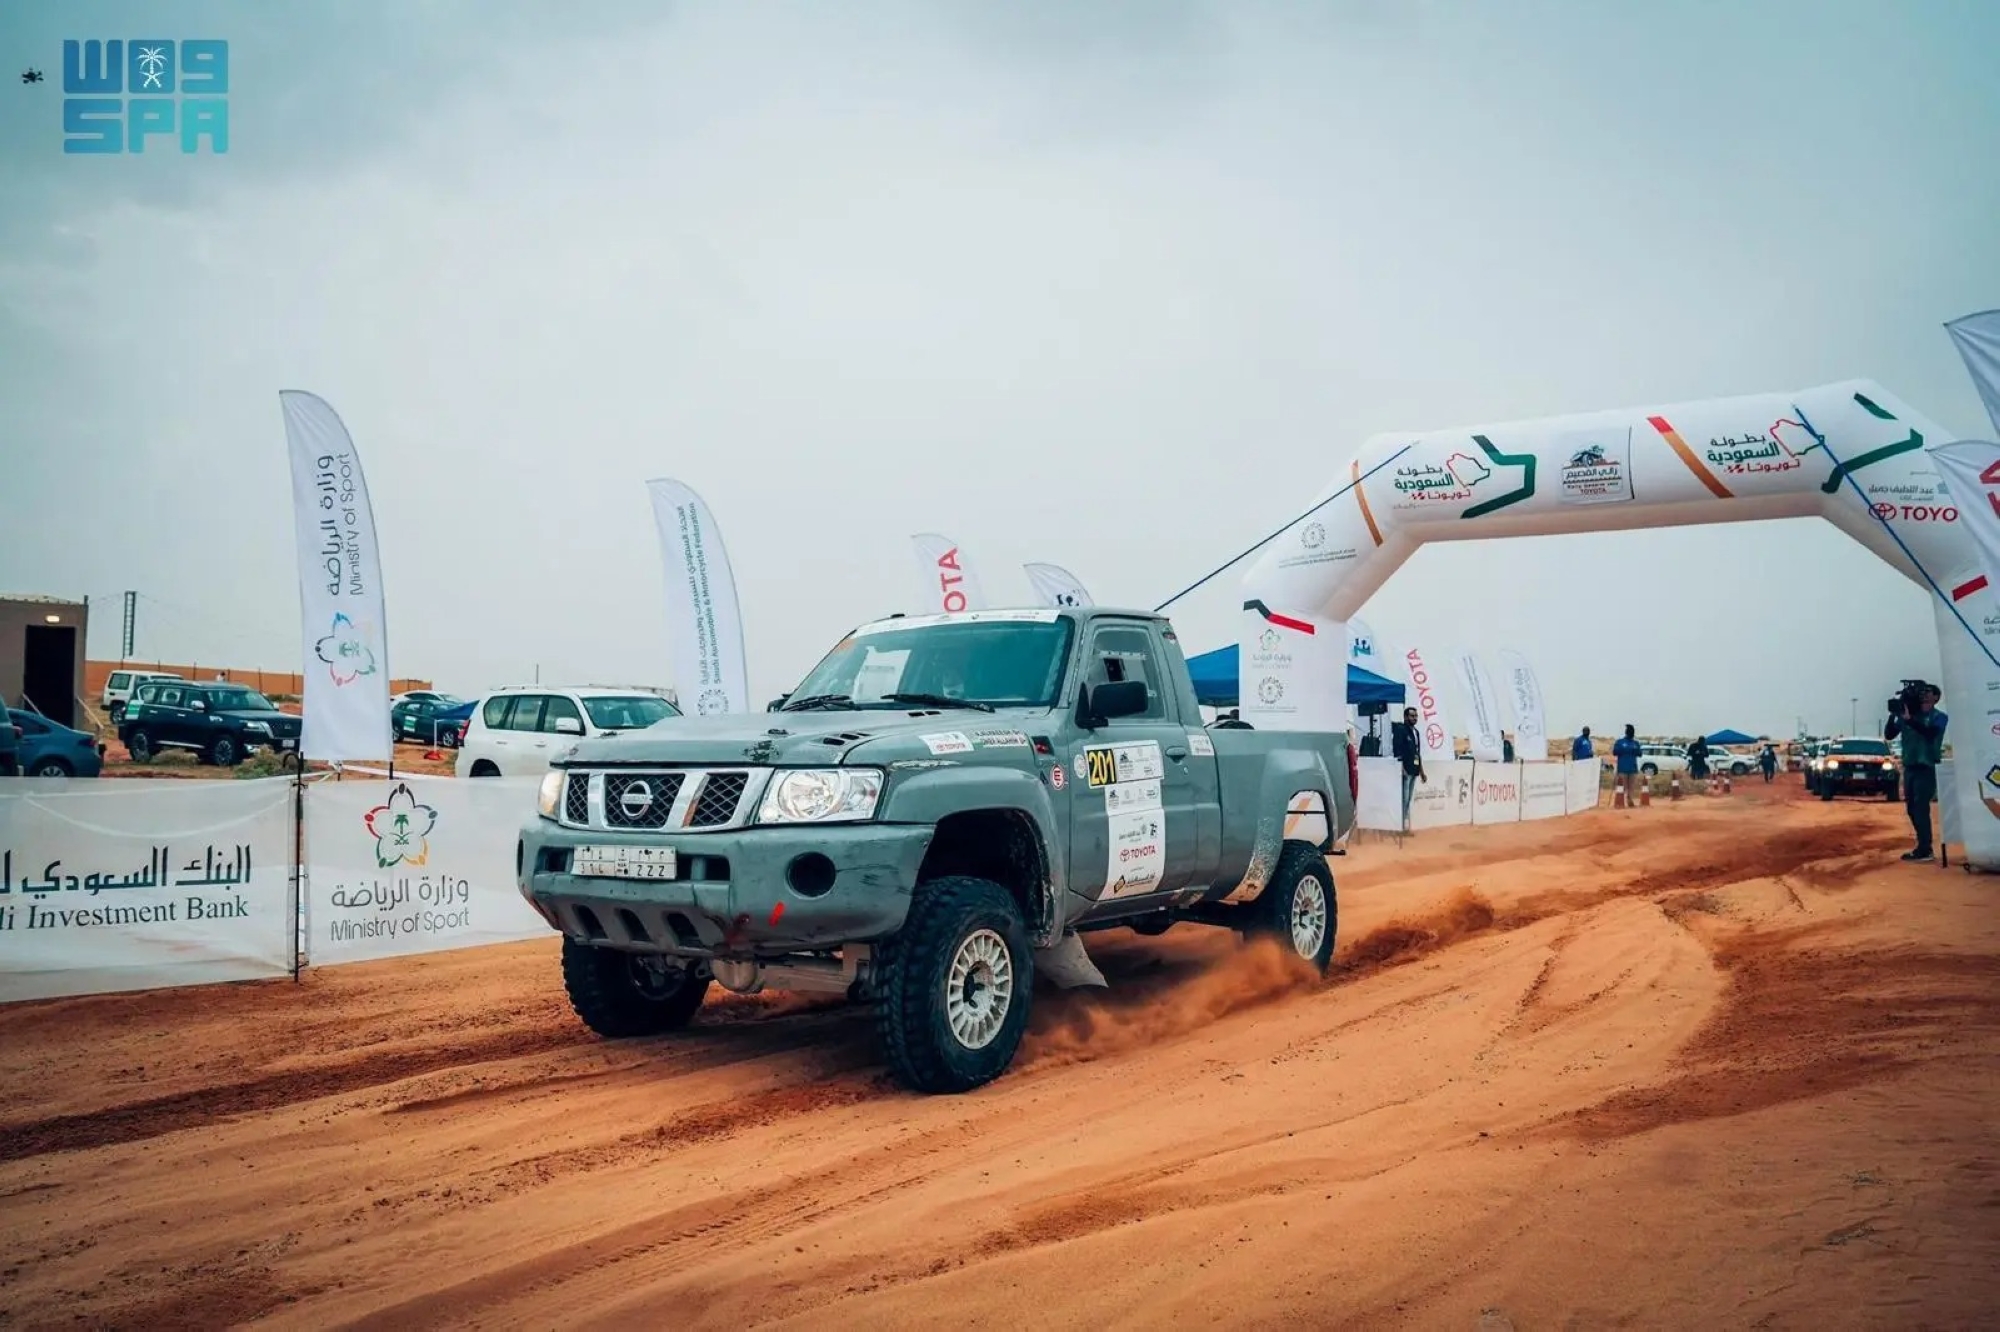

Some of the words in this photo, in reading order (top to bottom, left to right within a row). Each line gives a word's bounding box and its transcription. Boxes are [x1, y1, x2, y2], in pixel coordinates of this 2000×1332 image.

[1707, 441, 1780, 466] السعودية
[1710, 433, 1766, 448] بطولة
[336, 453, 355, 503] Sport
[1397, 463, 1444, 477] بطولة
[1747, 458, 1801, 473] تويوتا
[317, 455, 337, 510] وزارة
[1394, 473, 1455, 495] السعودية
[1427, 488, 1471, 501] تويوتا
[340, 508, 357, 525] of
[1901, 506, 1959, 523] TOYO
[320, 519, 342, 596] الرياضة
[347, 530, 364, 596] Ministry
[938, 547, 967, 613] OTA
[1407, 648, 1437, 721] TOYOTA
[1089, 749, 1115, 785] 201
[1488, 784, 1517, 802] TOYOTA
[175, 844, 250, 891] البنك
[1130, 845, 1156, 859] TOYOTA
[22, 845, 169, 900] السعودي
[331, 879, 410, 911] الرياضة
[419, 875, 469, 906] وزارة
[26, 900, 177, 930] Investment
[186, 895, 249, 921] Bank
[331, 917, 398, 941] Ministry
[401, 912, 420, 933] of
[424, 907, 470, 934] Sport
